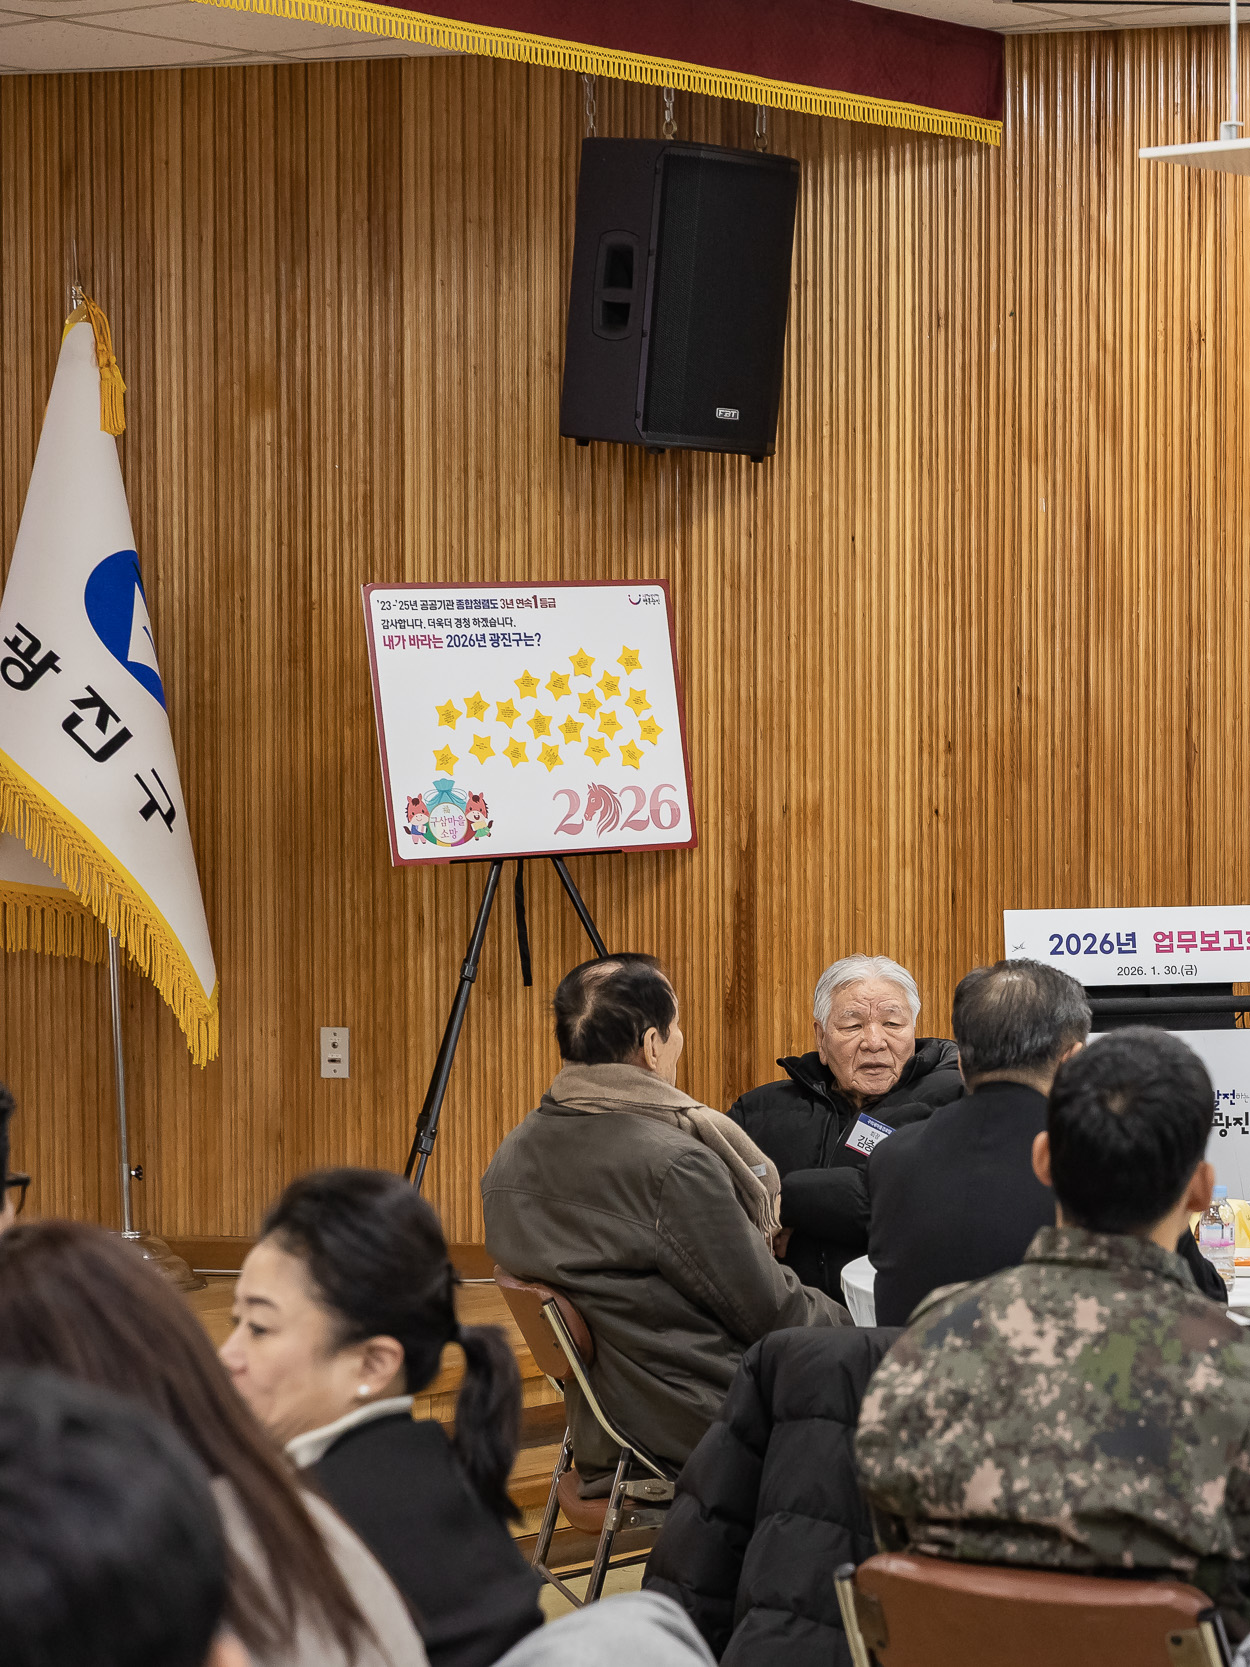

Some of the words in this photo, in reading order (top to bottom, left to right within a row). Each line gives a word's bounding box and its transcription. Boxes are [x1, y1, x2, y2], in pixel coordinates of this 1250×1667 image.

[419, 599, 454, 611] 공공기관
[455, 598, 499, 611] 종합청렴도
[500, 598, 514, 610] 3년
[381, 618, 426, 630] 감사합니다.
[427, 617, 453, 629] 더욱더
[454, 617, 471, 629] 경청
[472, 616, 517, 629] 하겠습니다.
[383, 634, 407, 651] 내가
[408, 634, 444, 650] 바라는
[446, 632, 487, 649] 2026년
[488, 632, 542, 648] 광진구는?
[1, 621, 176, 833] 광진구
[1048, 931, 1138, 956] 2026년
[1116, 966, 1147, 976] 2026.
[1150, 966, 1160, 976] 1.
[1163, 964, 1198, 977] 30.(금)
